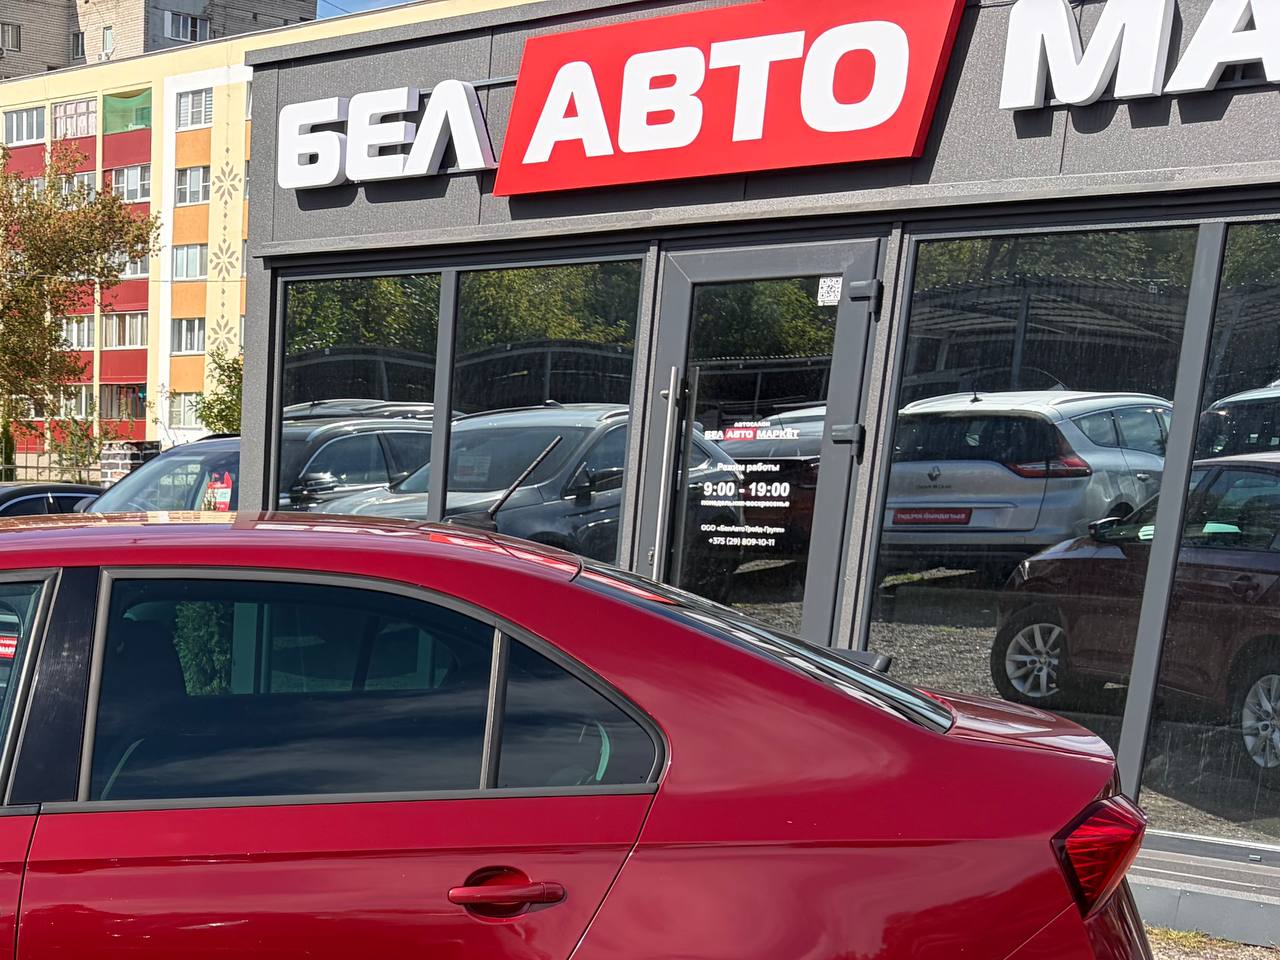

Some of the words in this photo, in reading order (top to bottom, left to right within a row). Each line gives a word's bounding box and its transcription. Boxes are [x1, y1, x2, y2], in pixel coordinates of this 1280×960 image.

[277, 79, 495, 190] БЕЛ
[522, 20, 910, 165] АВТО
[704, 430, 725, 440] БЕЛ
[726, 430, 754, 439] АВТО
[756, 429, 800, 440] МАРКЕТ
[746, 462, 780, 474] работы
[703, 481, 736, 497] 9:00
[748, 481, 791, 497] 19:00
[700, 524, 717, 532] ООО
[708, 537, 726, 545] +375
[726, 537, 741, 546] (29)
[741, 538, 776, 547] 809-10-11
